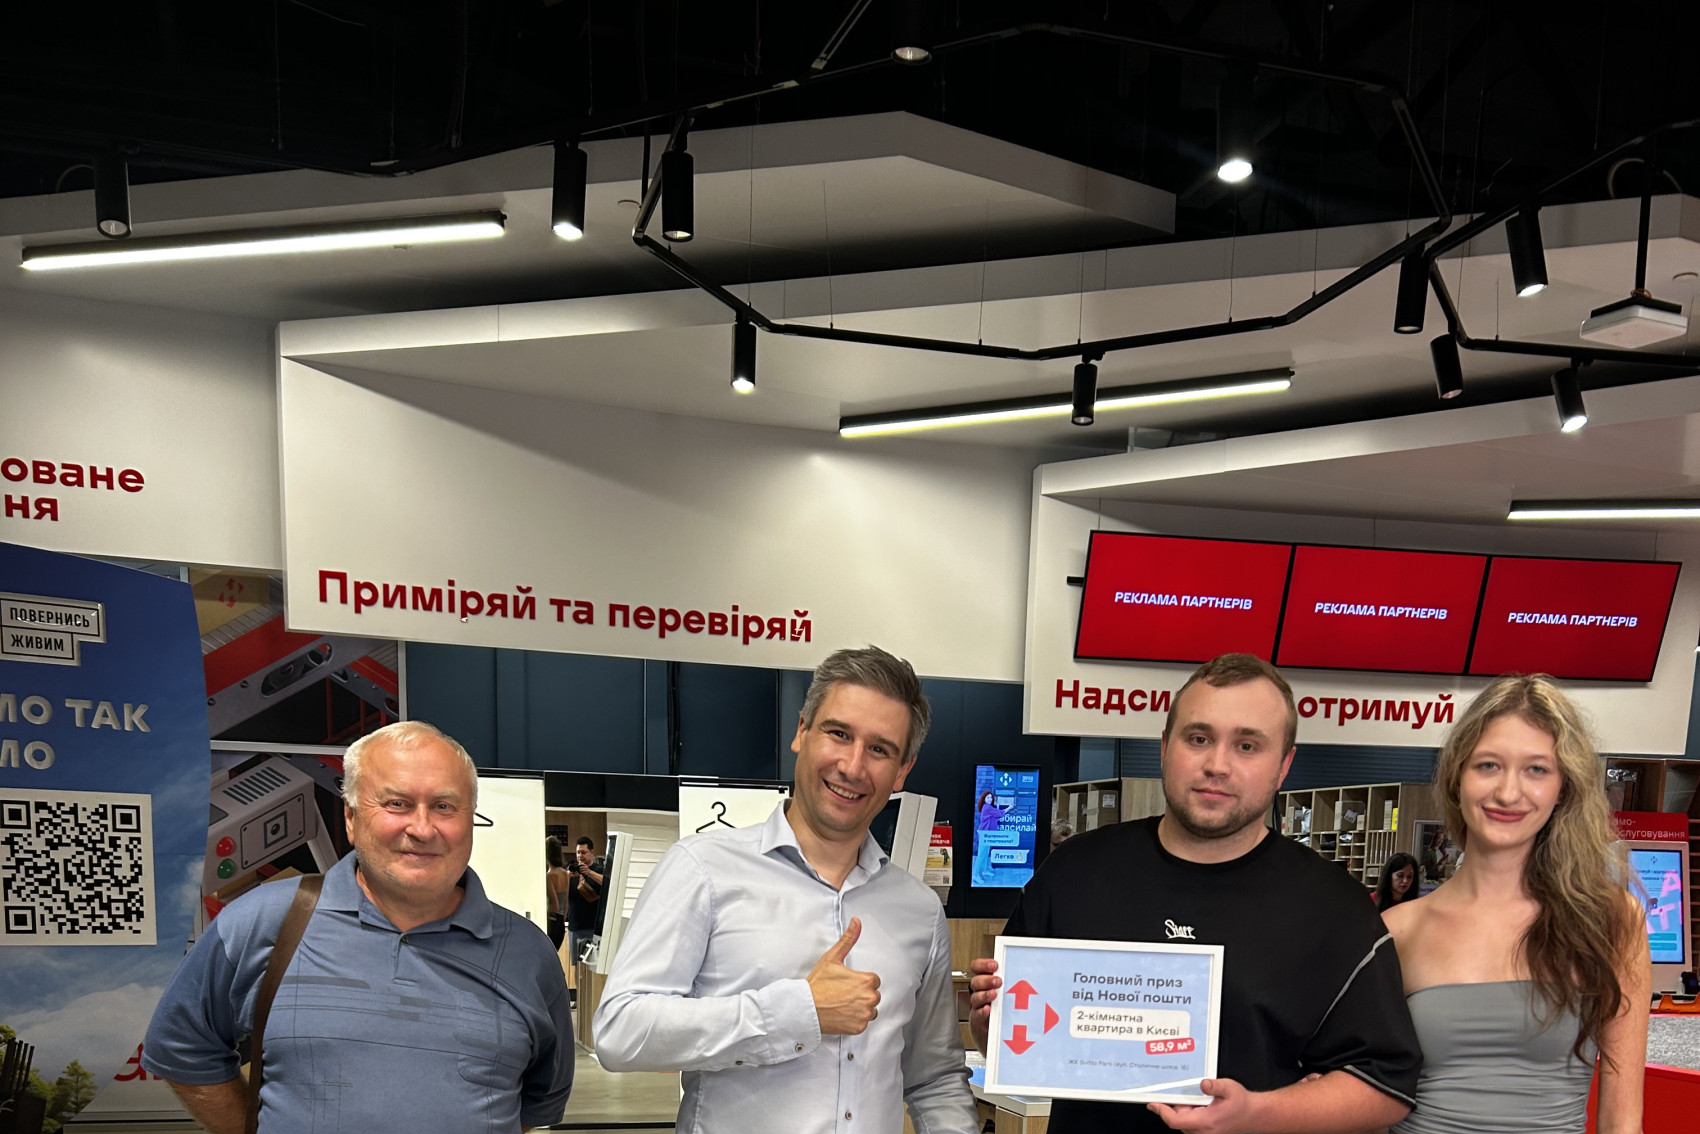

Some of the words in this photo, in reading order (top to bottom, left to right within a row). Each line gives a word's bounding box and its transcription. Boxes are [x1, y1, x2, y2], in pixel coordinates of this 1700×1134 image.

[1, 457, 146, 493] оване
[4, 494, 60, 522] ня
[318, 569, 538, 622] Приміряй
[549, 597, 595, 625] та
[609, 604, 813, 646] перевіряй
[1114, 591, 1179, 606] РЕКЛАМА
[1180, 595, 1253, 610] ПАРТНЕРІВ
[9, 607, 91, 628] ПОВЕРНИСЬ
[1314, 602, 1376, 616] РЕКЛАМА
[1378, 605, 1448, 620] ПАРТНЕРІВ
[1507, 612, 1568, 625] РЕКЛАМА
[1569, 614, 1639, 628] ПАРТНЕРІВ
[11, 634, 65, 652] ЖИВИМ
[1055, 678, 1172, 716] Надси
[1297, 693, 1455, 730] отримуй
[64, 698, 152, 733] ТАК
[999, 813, 1033, 824] абирай
[1616, 818, 1636, 826] мо-
[997, 823, 1037, 832] адсилай
[1617, 829, 1686, 840] слуговування
[1073, 972, 1143, 987] Головний
[1147, 977, 1184, 989] приз
[1072, 988, 1095, 1002] від
[1098, 990, 1141, 1003] Нової
[1143, 994, 1192, 1005] пошти
[1077, 1011, 1144, 1024] 2-кімнатна
[1077, 1023, 1134, 1036] квартира
[1146, 1026, 1180, 1037] Києві
[1149, 1042, 1176, 1053] 58,9
